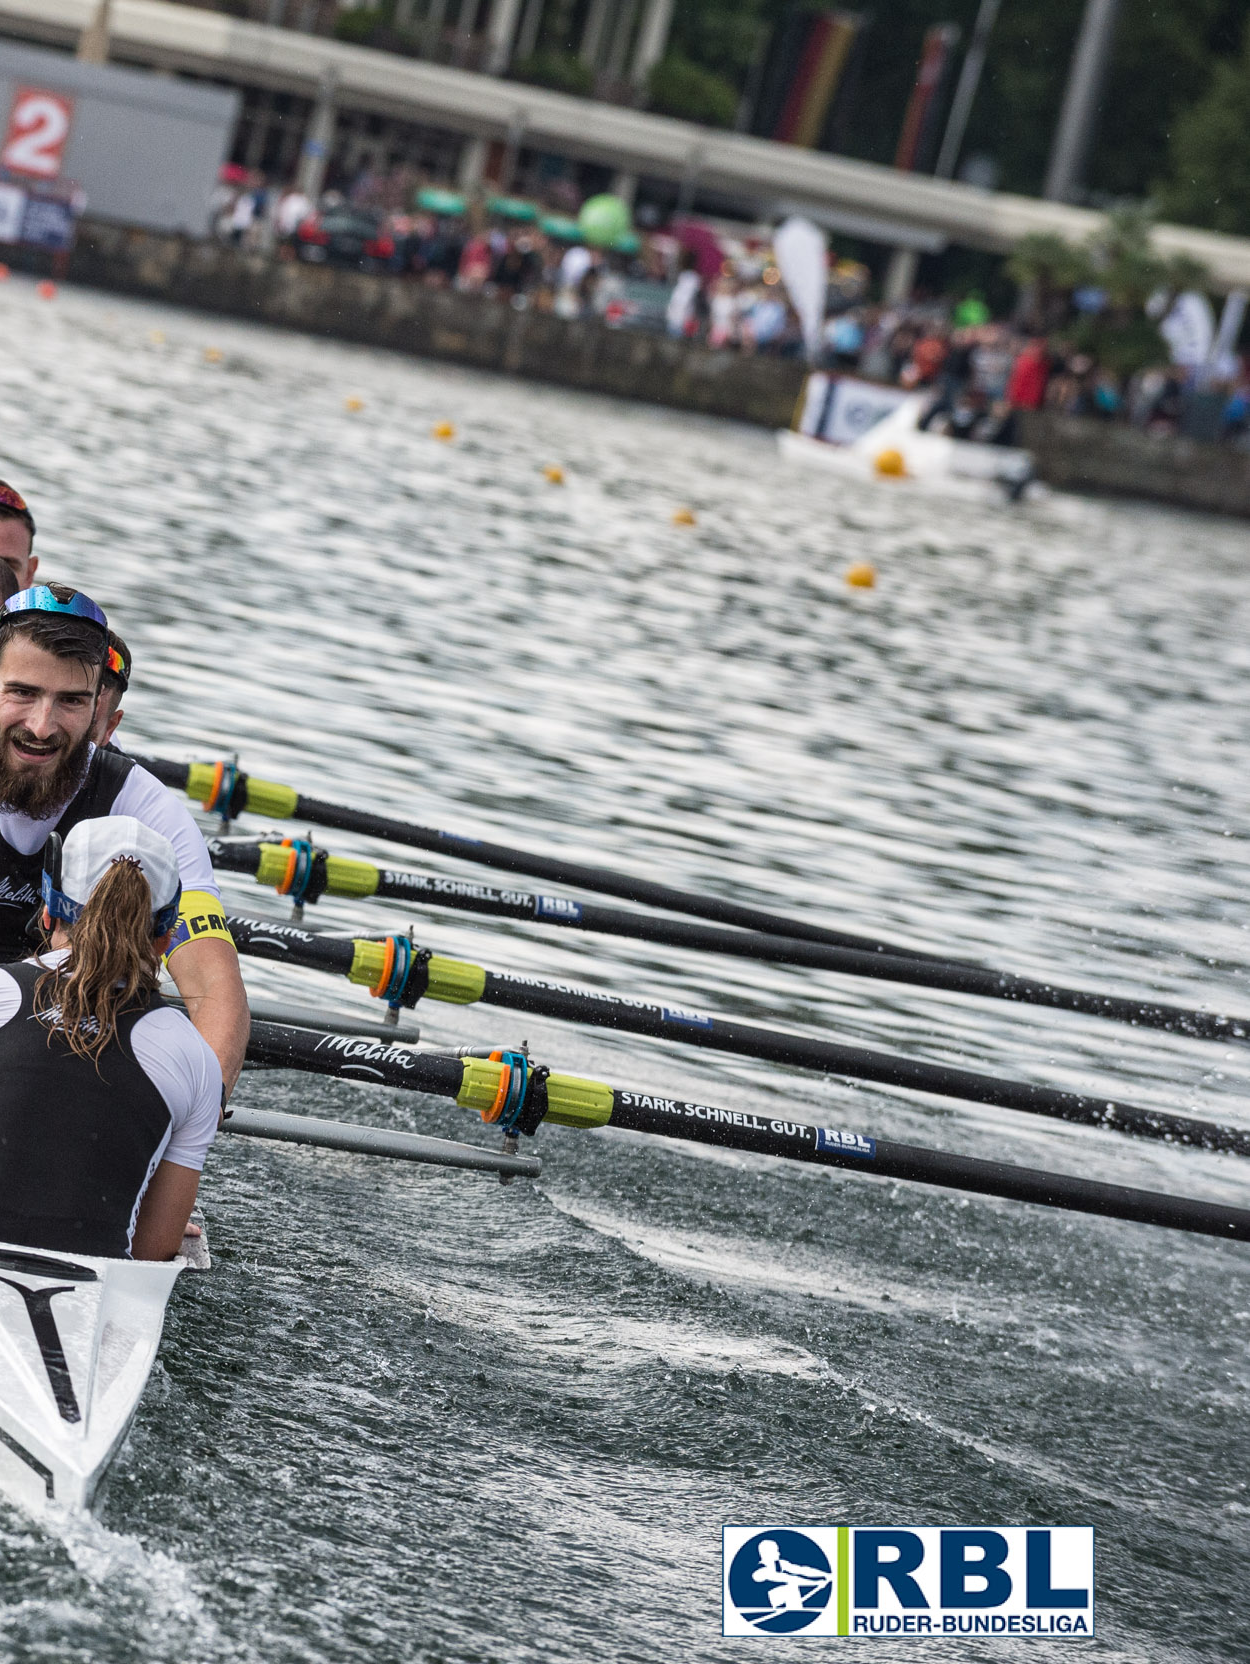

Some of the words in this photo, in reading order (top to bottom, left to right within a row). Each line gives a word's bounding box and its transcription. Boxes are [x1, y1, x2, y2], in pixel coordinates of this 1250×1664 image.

[3, 97, 70, 173] 2
[384, 870, 433, 890] STARK.
[500, 890, 533, 908] GUT.
[543, 896, 579, 914] RBL
[621, 1092, 682, 1114] STARK.
[684, 1103, 767, 1131] SCHNELL.
[770, 1120, 811, 1139] GUT.
[824, 1129, 871, 1149] RBL
